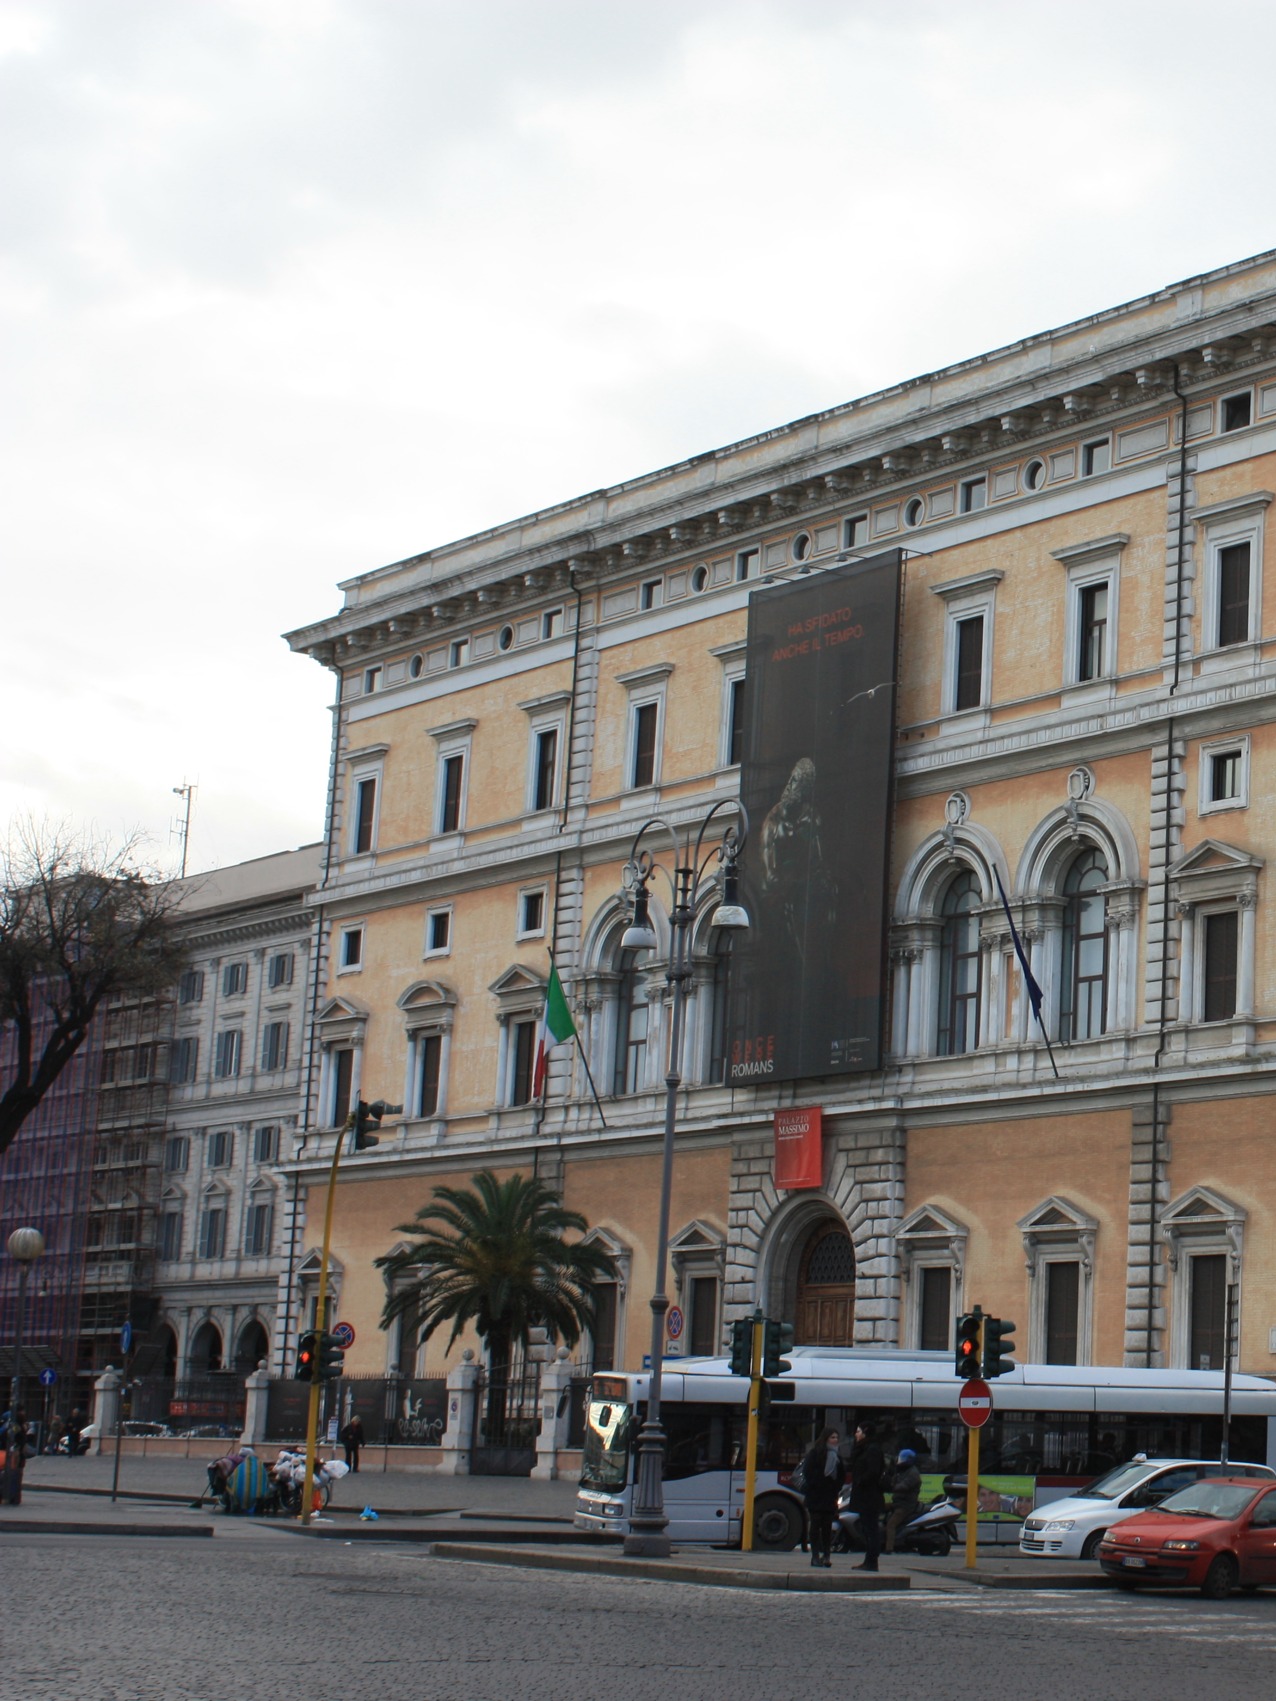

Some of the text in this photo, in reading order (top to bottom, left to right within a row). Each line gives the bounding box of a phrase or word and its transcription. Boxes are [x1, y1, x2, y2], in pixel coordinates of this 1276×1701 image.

[787, 607, 852, 637] HA SFIDATO
[771, 640, 810, 662] ANCHE
[812, 637, 822, 651] IL
[731, 1059, 774, 1078] ROMANS
[778, 1123, 810, 1135] MASSIMO
